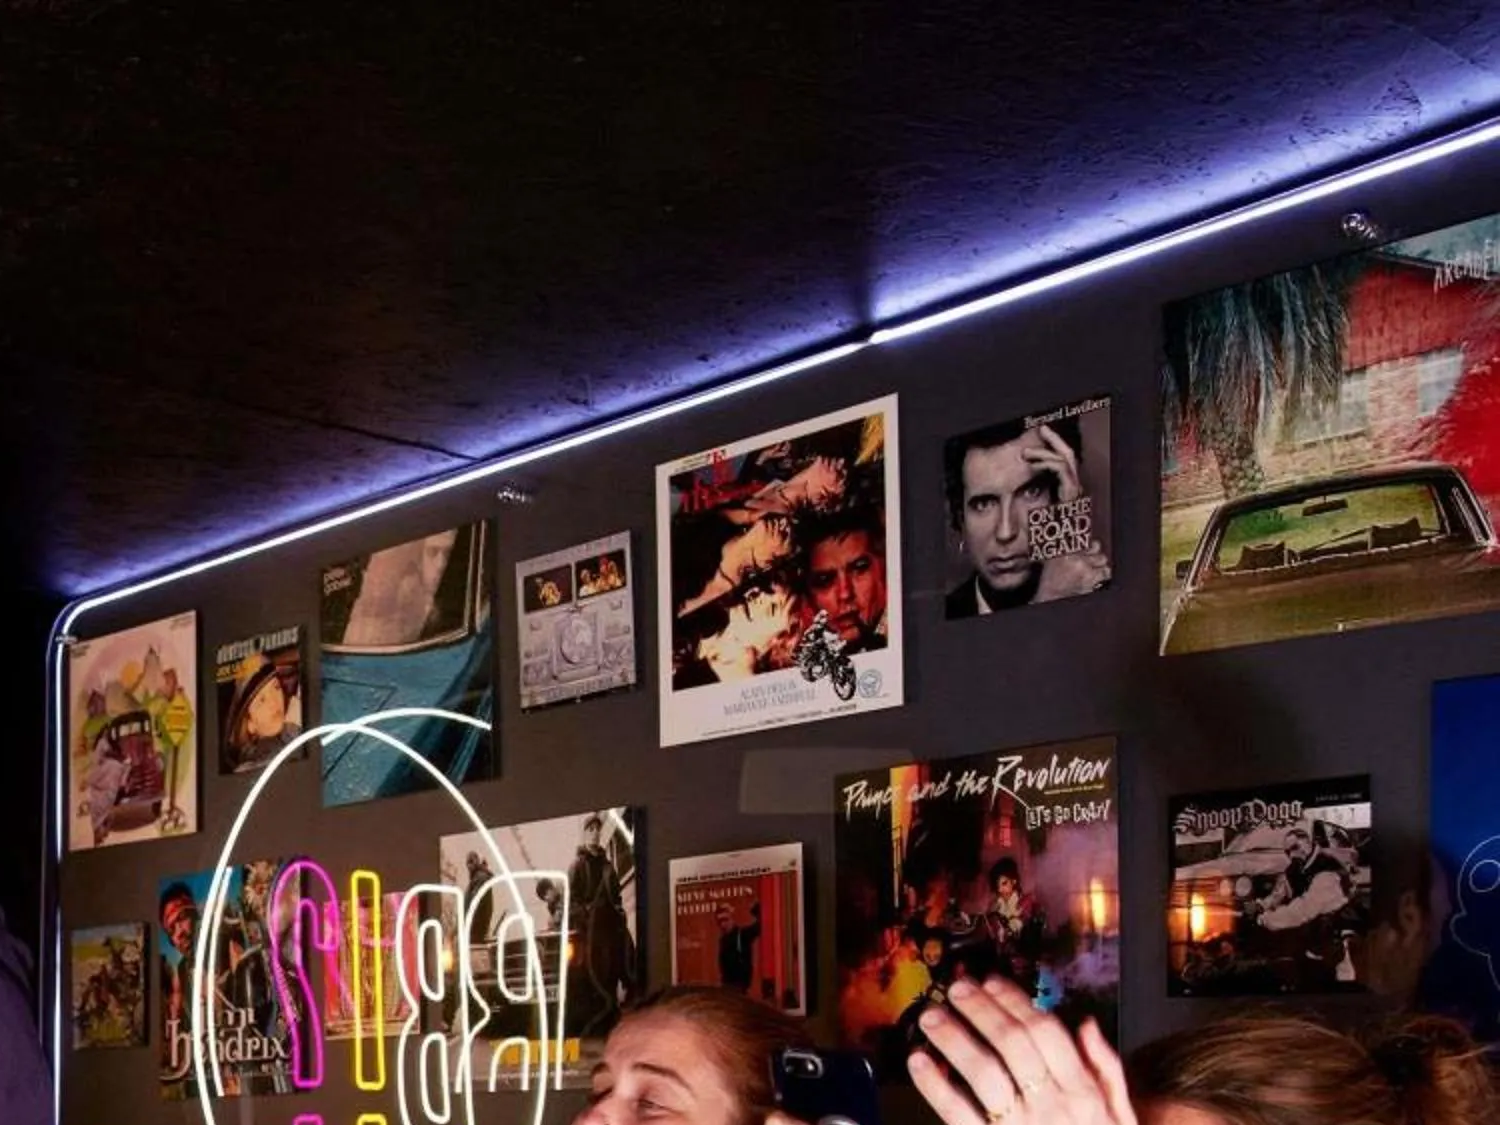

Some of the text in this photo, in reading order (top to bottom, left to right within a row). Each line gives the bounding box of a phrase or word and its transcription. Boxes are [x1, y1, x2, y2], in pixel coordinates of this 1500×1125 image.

[1029, 496, 1091, 525] ON THE
[1029, 515, 1092, 545] ROAD
[1030, 534, 1091, 561] AGAIN
[908, 771, 952, 803] and
[955, 769, 990, 802] the
[1172, 798, 1304, 834] Snoop Dogg
